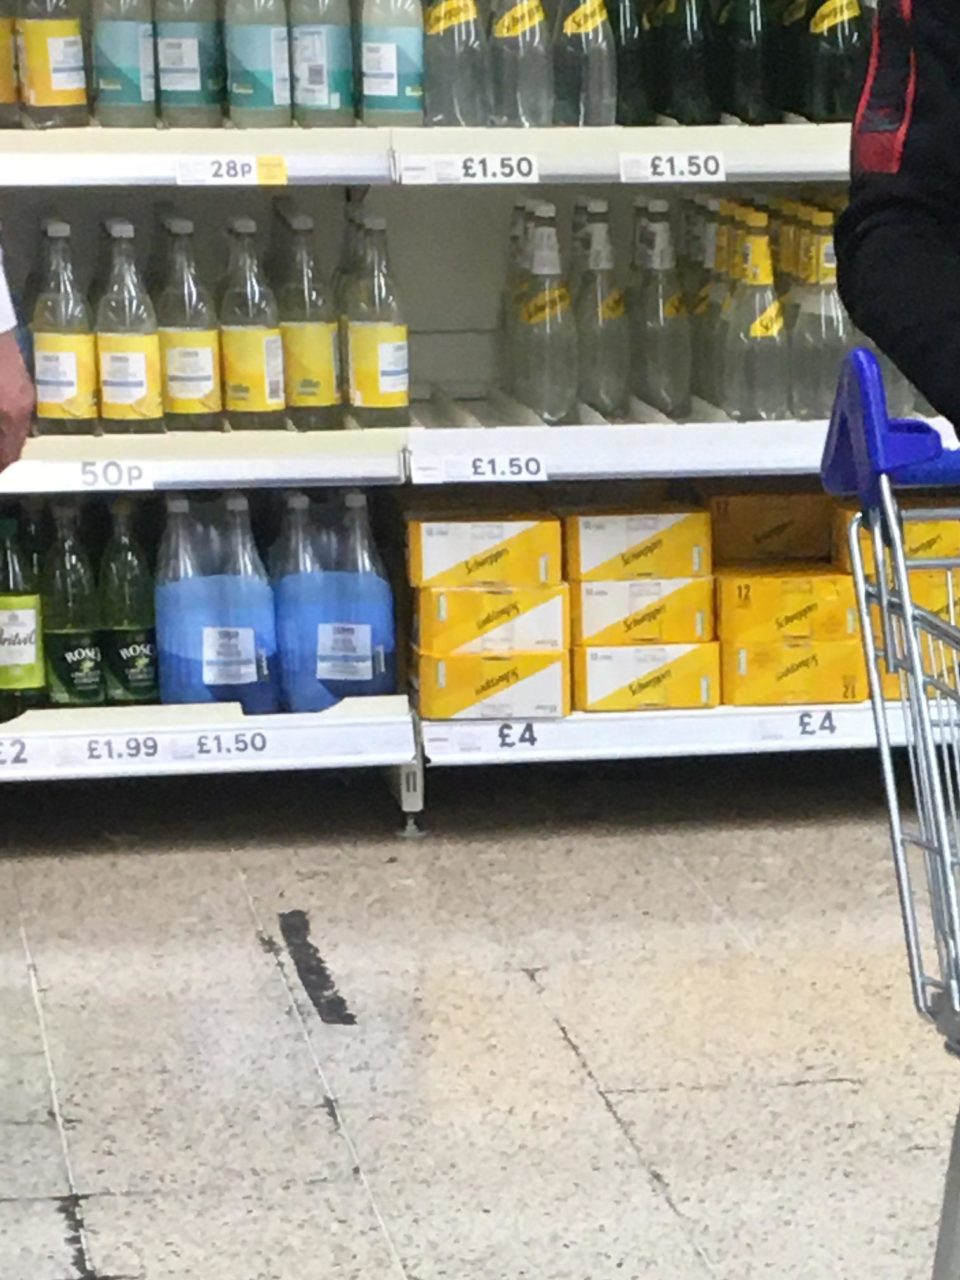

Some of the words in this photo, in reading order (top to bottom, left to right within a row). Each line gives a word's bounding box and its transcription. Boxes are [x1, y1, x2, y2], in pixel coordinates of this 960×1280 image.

[211, 160, 252, 179] 28p
[462, 157, 533, 179] £1.50
[650, 155, 720, 177] £1.50
[80, 461, 143, 487] 50p
[471, 457, 541, 478] £1.50
[737, 584, 751, 601] 12
[799, 711, 837, 736] £4
[197, 733, 267, 755] £1.50
[498, 722, 538, 748] £4
[87, 736, 158, 760] £1.99
